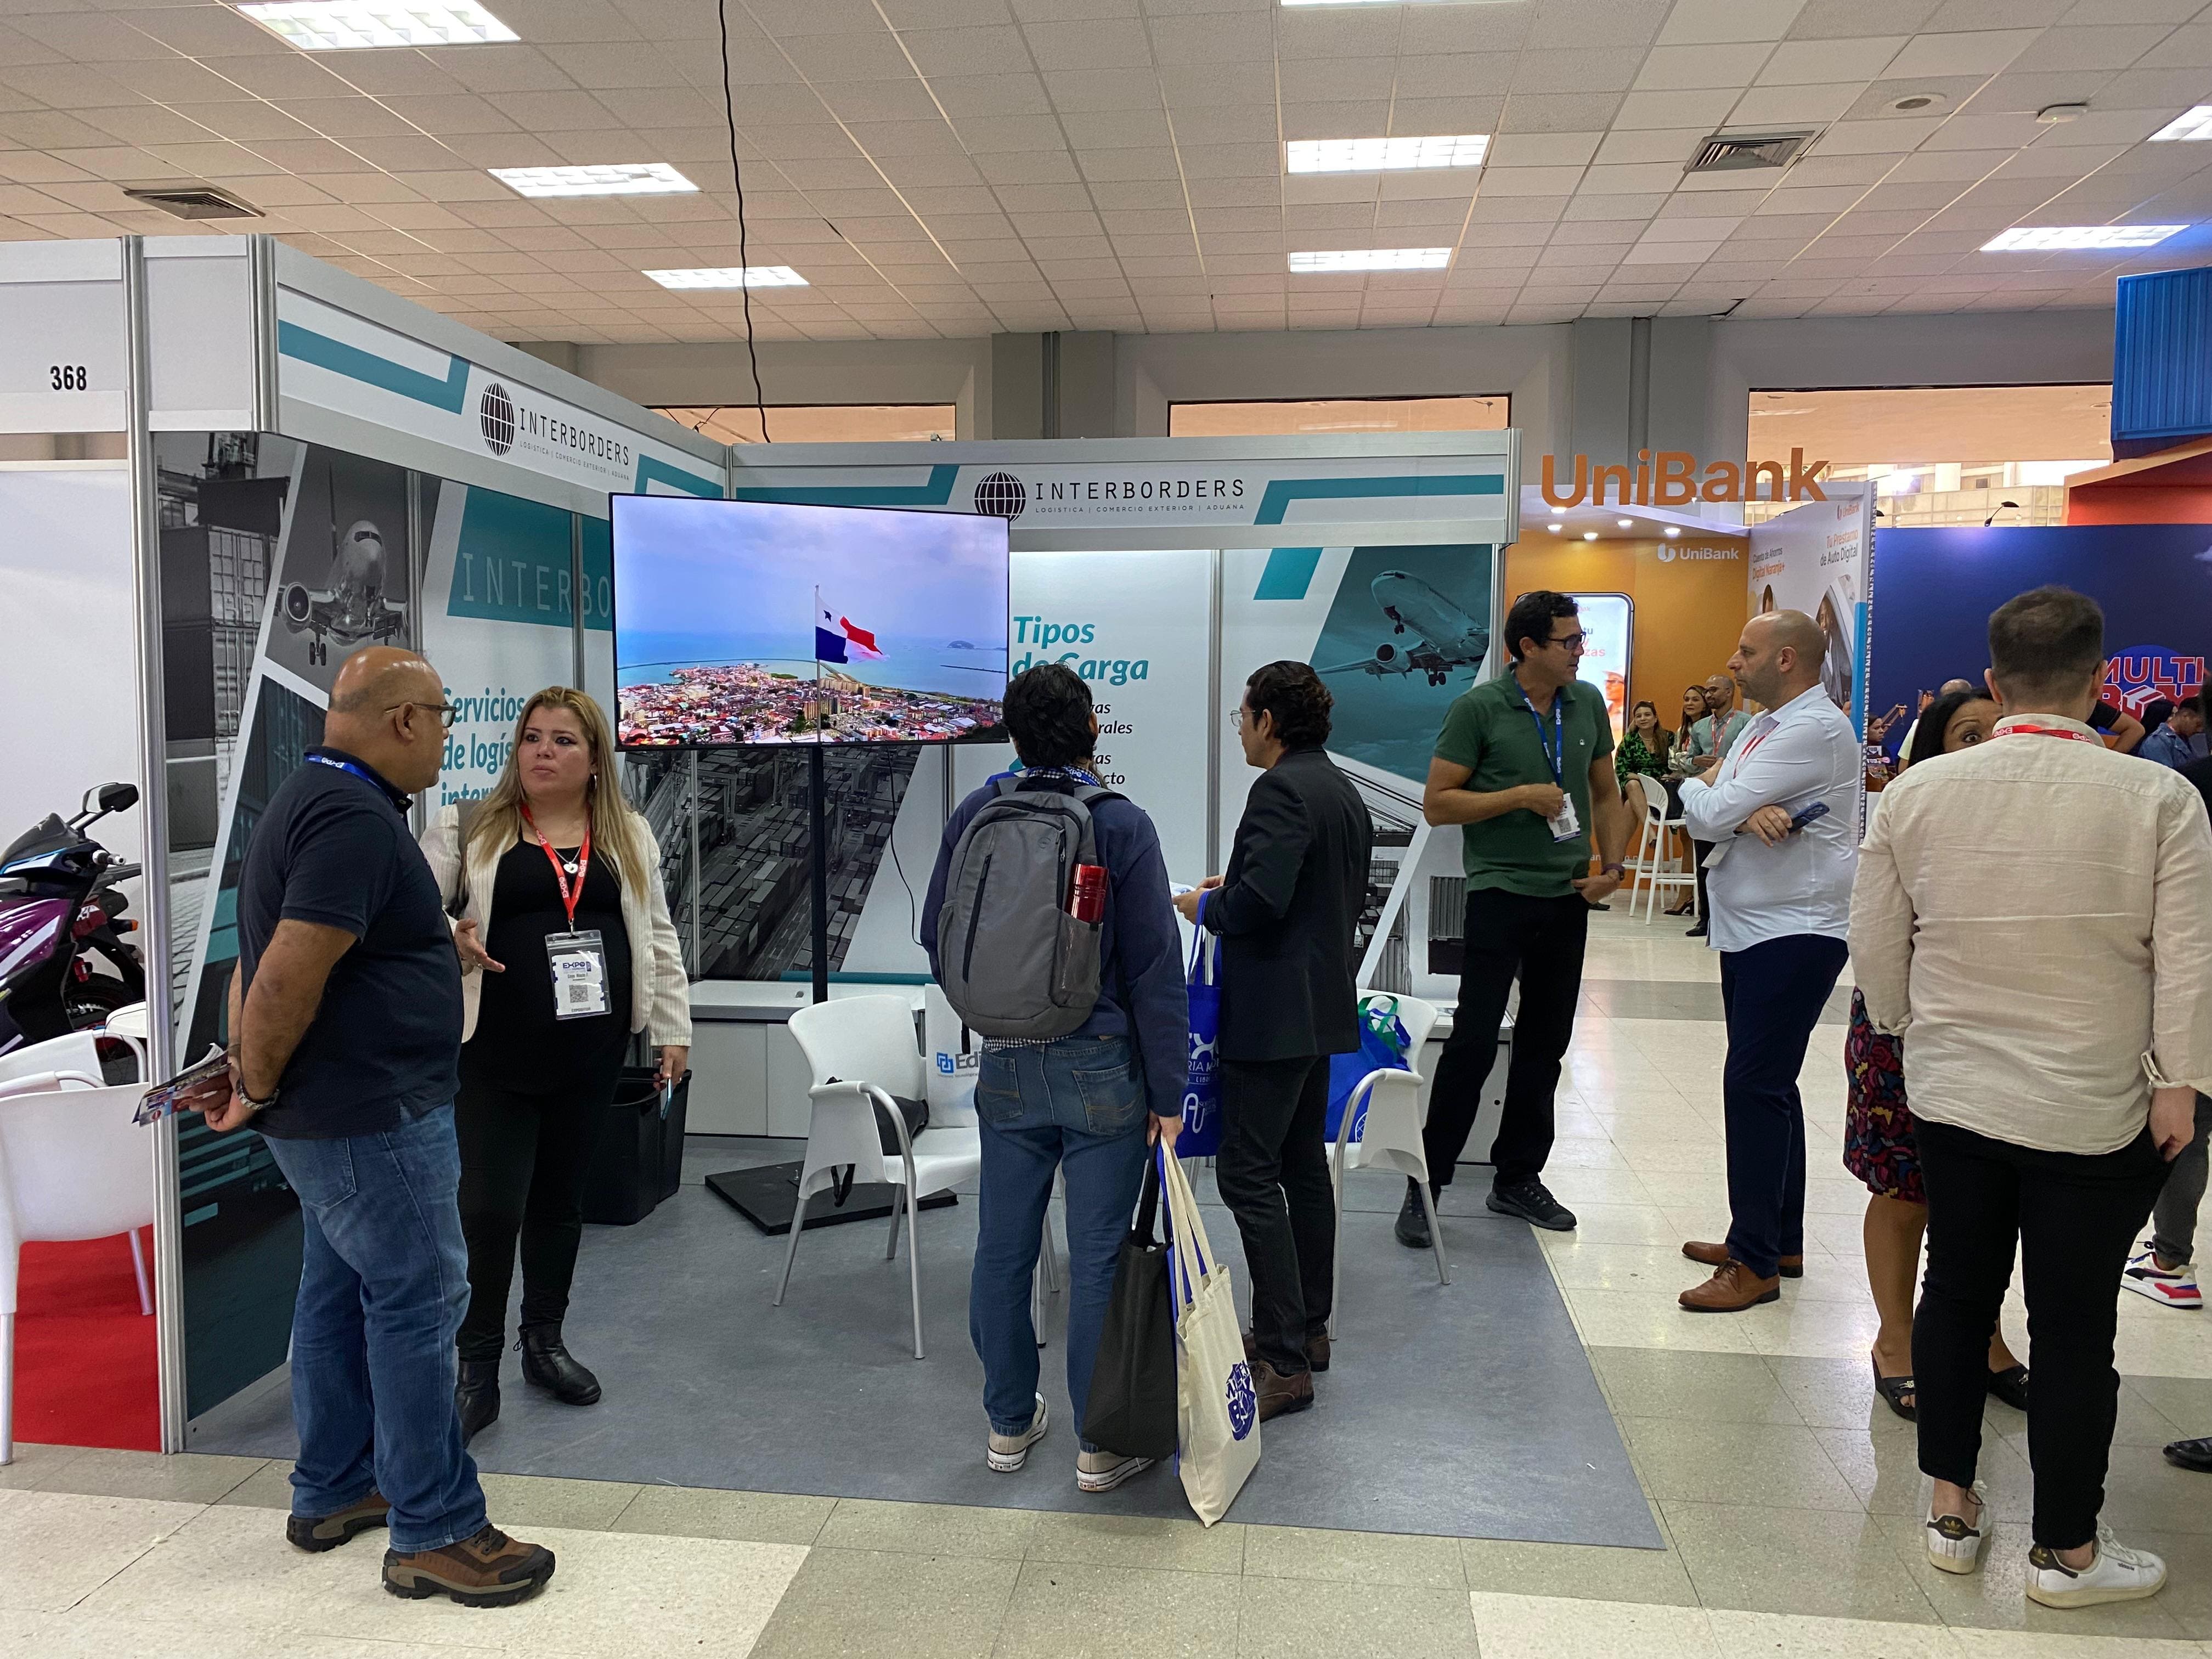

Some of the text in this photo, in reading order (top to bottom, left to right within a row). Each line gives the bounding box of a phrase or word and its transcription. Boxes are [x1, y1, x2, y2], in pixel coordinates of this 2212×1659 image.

[50, 365, 87, 391] 368
[520, 408, 629, 466] INTERBORDERS
[555, 452, 581, 466] COMERCIO
[583, 461, 606, 474] EXTERIOR
[1541, 448, 1829, 508] UniBank
[1036, 479, 1244, 500] INTERBORDERS
[1826, 535, 1832, 549] Tu
[1679, 548, 1739, 560] UniBank
[1820, 543, 1858, 566] de Auto Digital
[462, 552, 610, 618] INTERBO
[1013, 616, 1095, 649] Tipos
[1099, 720, 1133, 734] rales
[442, 732, 514, 775] de logís
[1068, 768, 1082, 777] XPO
[578, 859, 588, 877] EXPO
